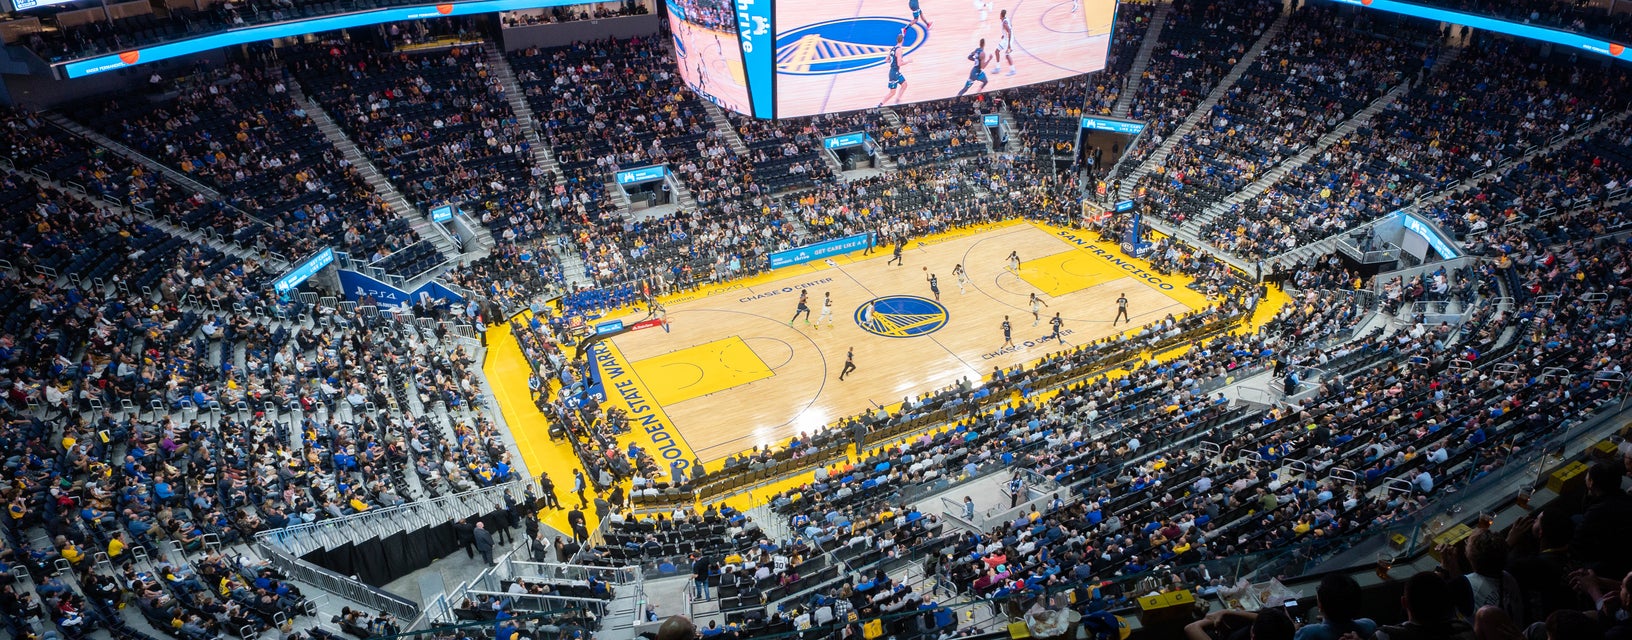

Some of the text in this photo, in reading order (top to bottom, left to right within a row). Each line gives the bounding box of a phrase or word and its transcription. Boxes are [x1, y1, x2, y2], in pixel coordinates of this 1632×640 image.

[738, 0, 755, 53] hrive
[1057, 230, 1174, 290] SAN FRANCISCO
[739, 277, 833, 303] CHASE CENTER
[615, 379, 651, 414] STATE
[638, 413, 689, 470] GOLDEN
[775, 561, 784, 570] 30
